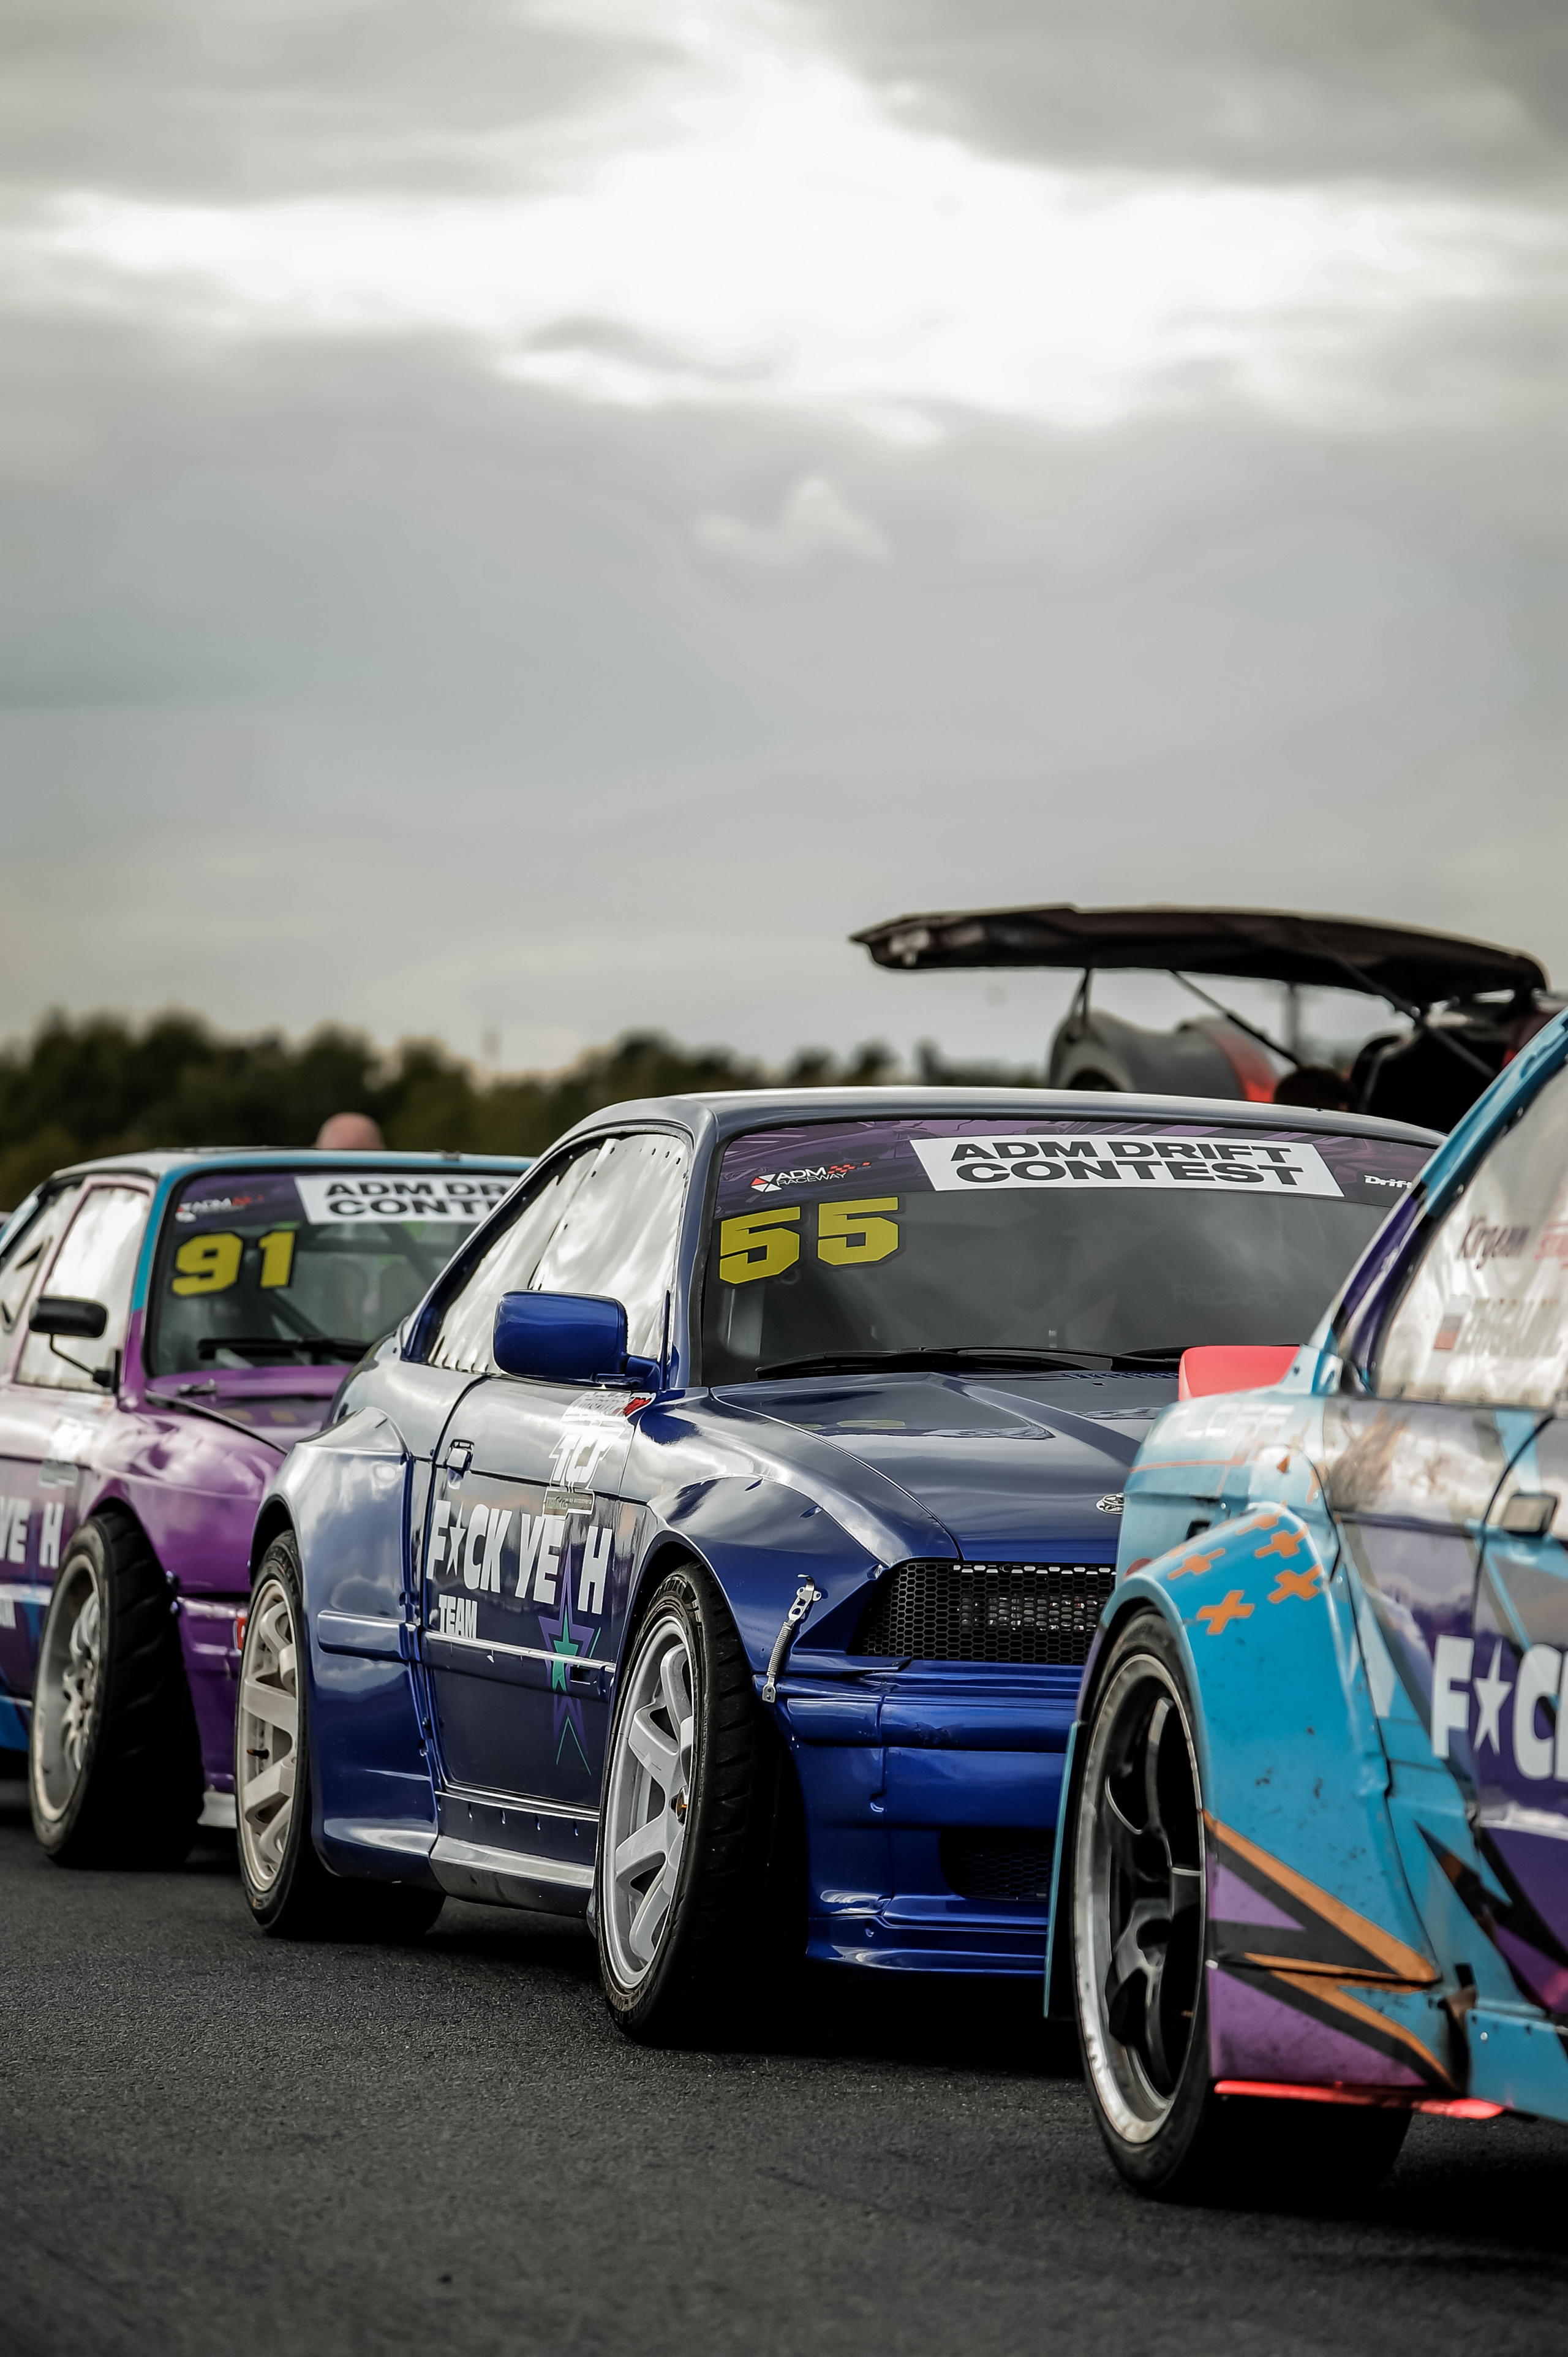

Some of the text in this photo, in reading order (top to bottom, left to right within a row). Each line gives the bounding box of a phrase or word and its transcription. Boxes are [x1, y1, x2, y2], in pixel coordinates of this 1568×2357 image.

[951, 1141, 1292, 1163] ADM DRIFT
[775, 1167, 827, 1181] ADM
[776, 1172, 847, 1187] RACEWAY
[956, 1160, 1304, 1186] CONTEST
[326, 1182, 433, 1197] ADM
[719, 1196, 899, 1285] 55
[172, 1231, 295, 1296] 91
[1171, 1284, 1285, 1307] RECARO
[439, 1594, 478, 1639] TEAM
